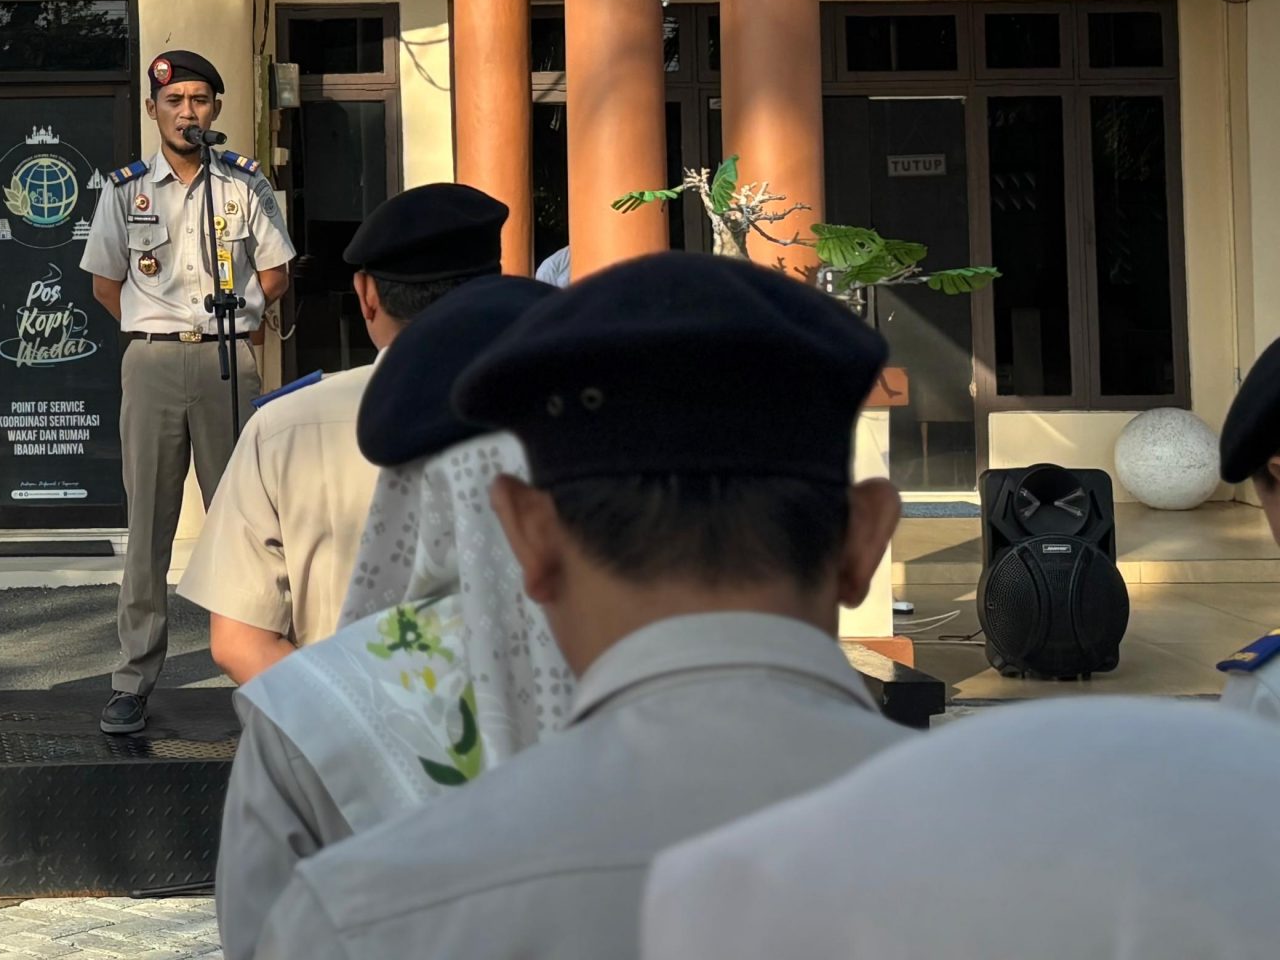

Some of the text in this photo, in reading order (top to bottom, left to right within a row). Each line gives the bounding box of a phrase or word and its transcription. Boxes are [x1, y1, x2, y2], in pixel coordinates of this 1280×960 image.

[890, 159, 942, 172] TUTUP
[26, 280, 61, 307] Pos
[19, 302, 73, 338] Kopi
[16, 327, 88, 368] Wadai
[11, 400, 85, 413] POINT OF SERVICE
[49, 414, 100, 427] SERTIFIKASI
[7, 429, 90, 441] WAKAF DAN RUMAH
[14, 443, 85, 456] IBADAH LAINNYA
